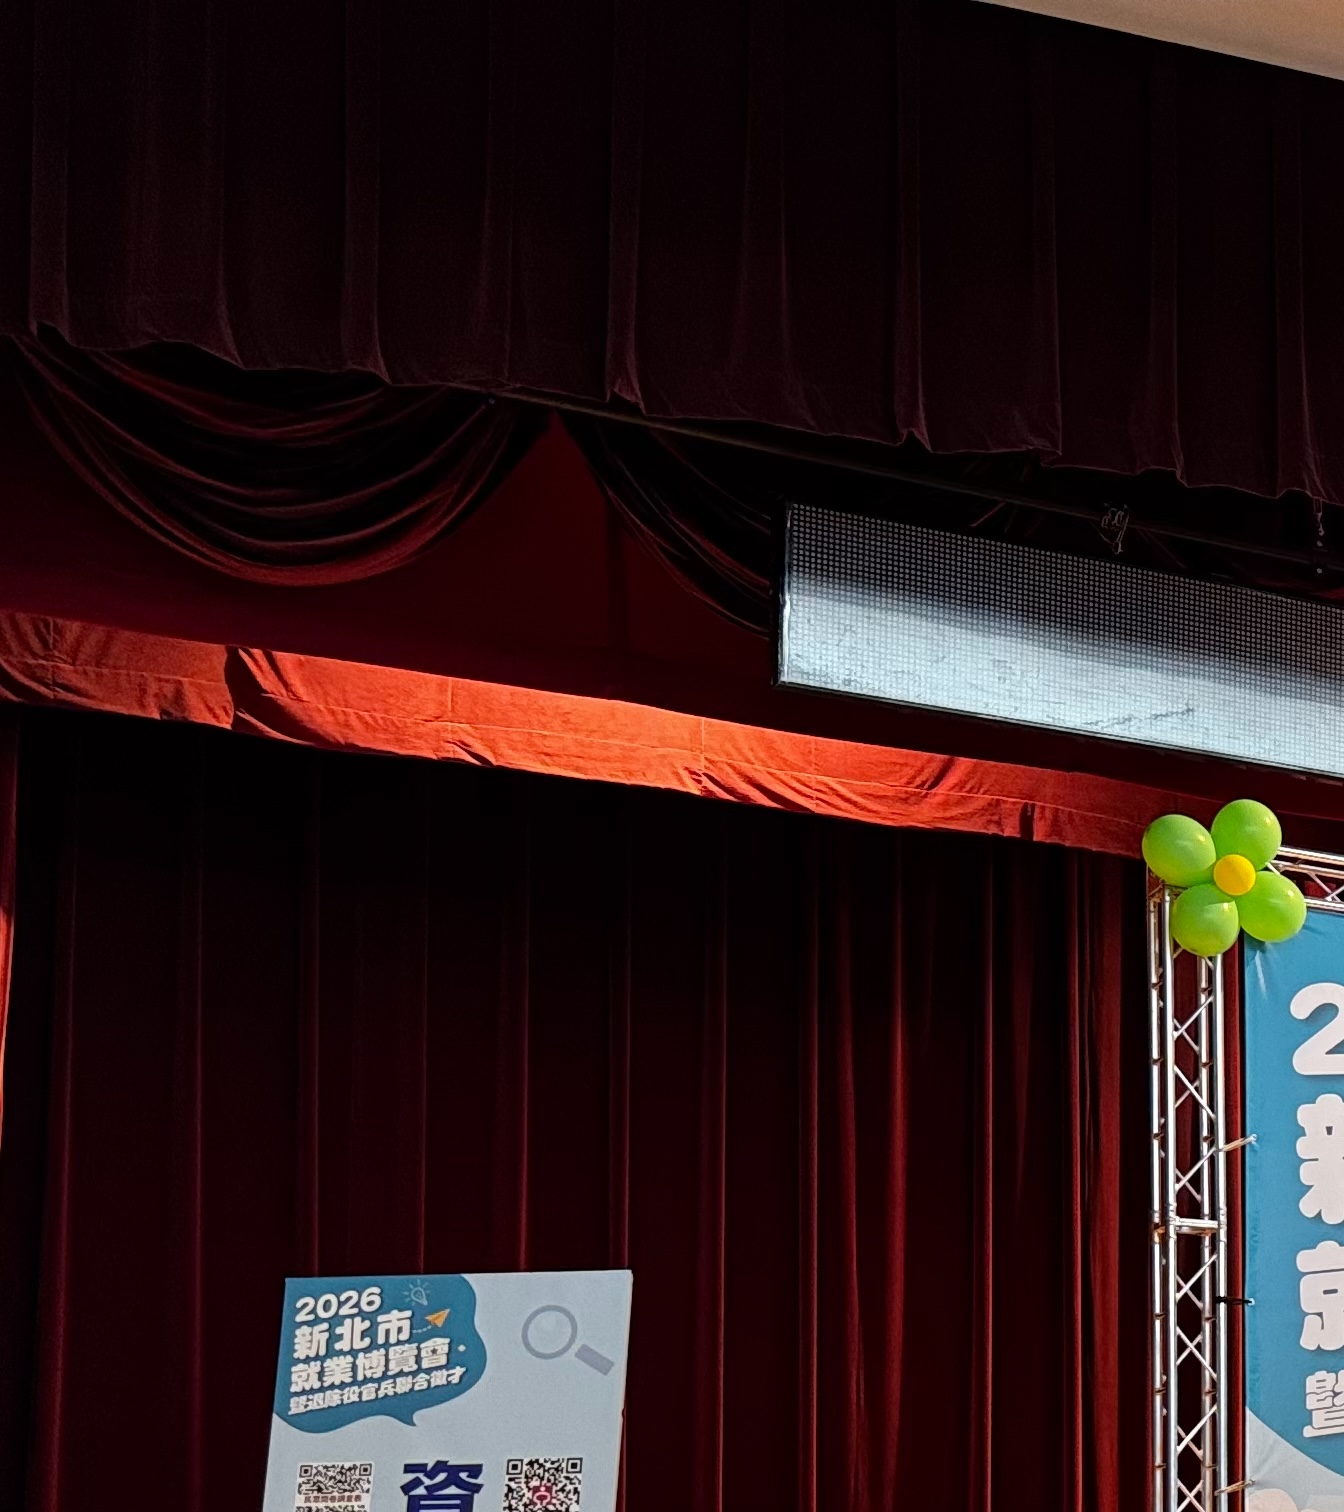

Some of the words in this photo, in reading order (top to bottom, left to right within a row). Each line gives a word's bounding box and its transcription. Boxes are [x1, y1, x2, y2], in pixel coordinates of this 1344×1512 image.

[294, 1286, 382, 1323] 2026
[293, 1309, 413, 1360] 新北市
[290, 1337, 450, 1393] 就業博覽會
